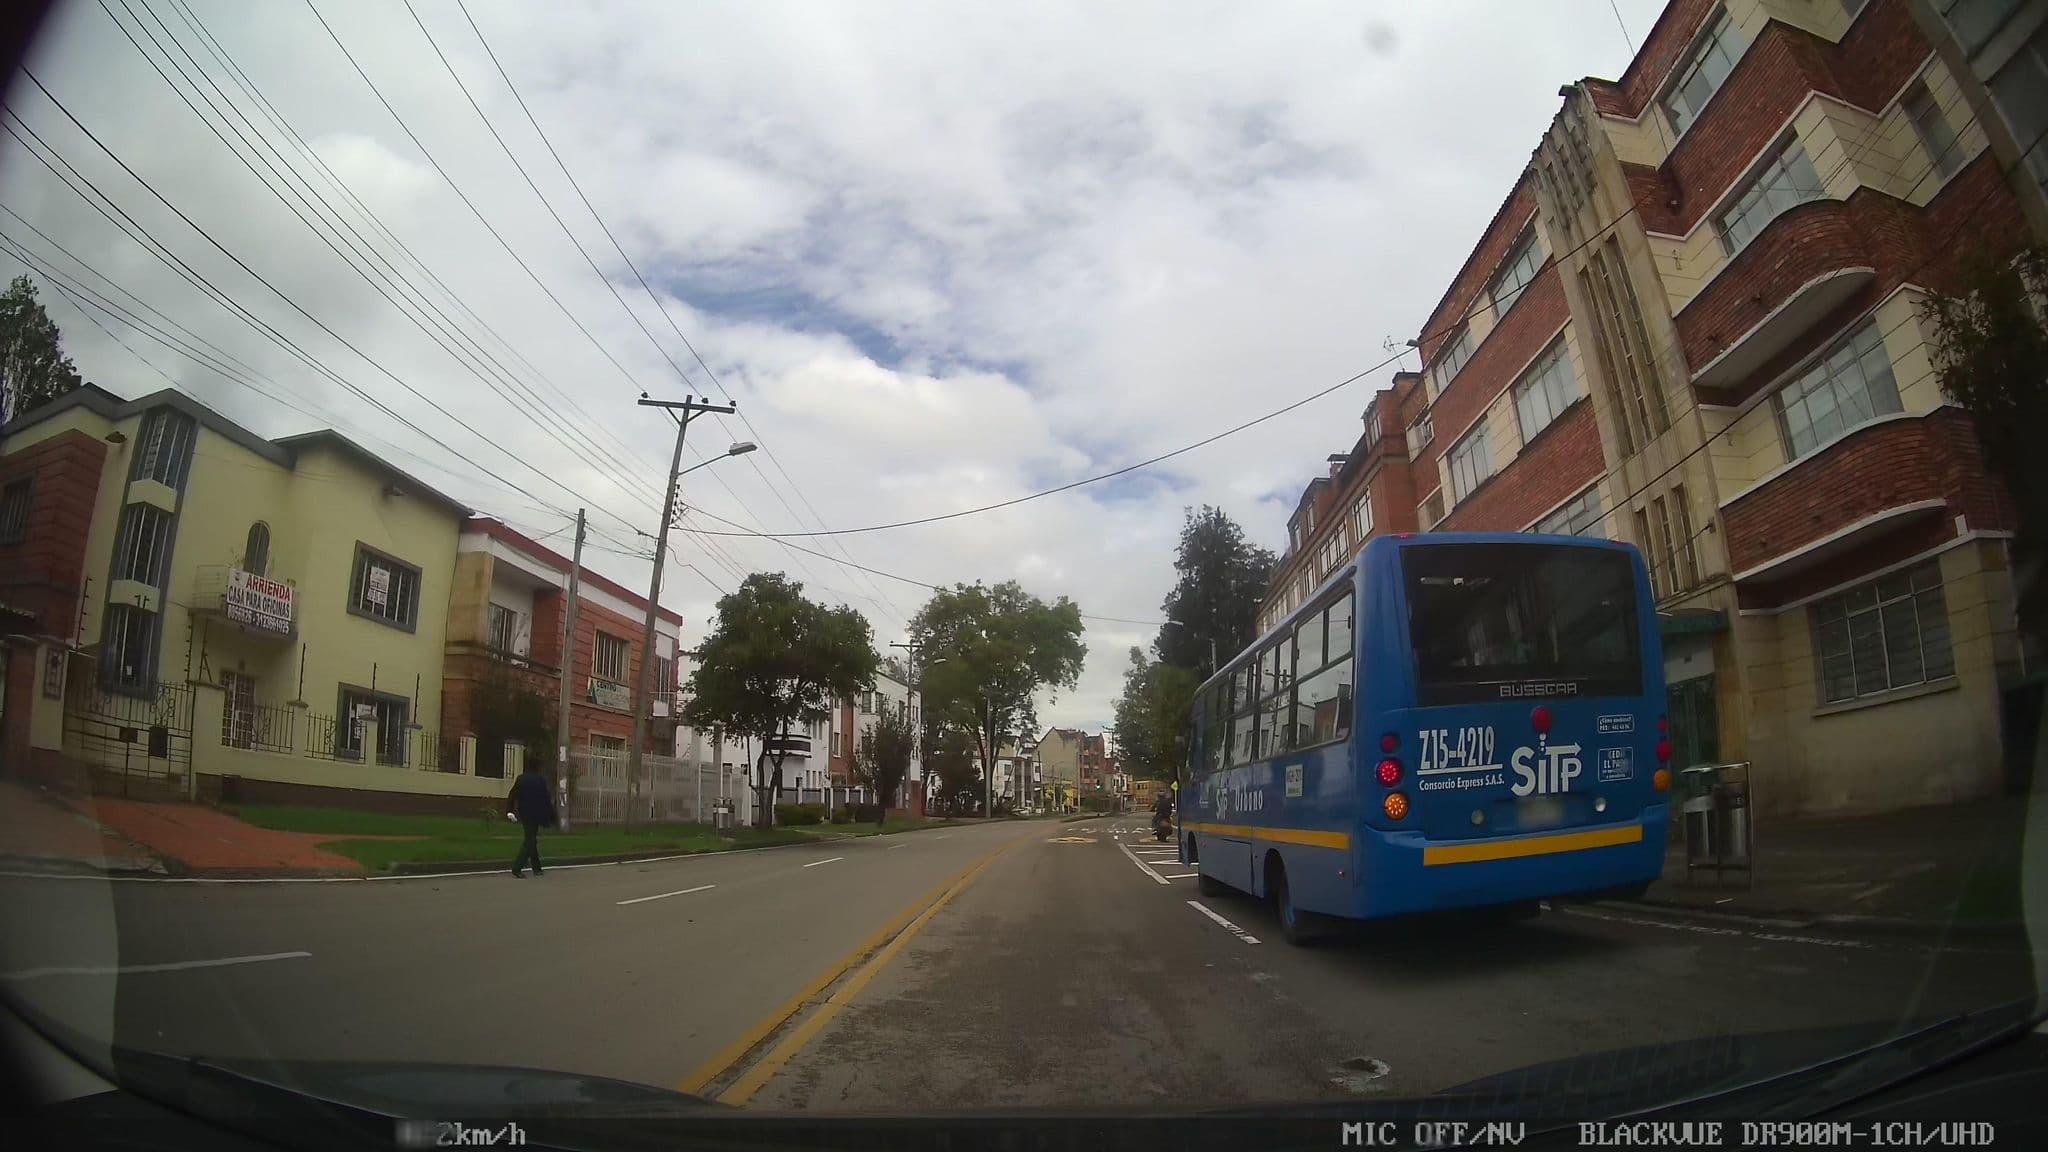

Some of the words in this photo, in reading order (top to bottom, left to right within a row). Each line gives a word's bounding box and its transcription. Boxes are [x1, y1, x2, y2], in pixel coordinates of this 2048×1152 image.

[246, 575, 290, 601] ARRIENDA
[228, 586, 245, 605] CASA
[246, 591, 262, 610] PARA
[263, 596, 290, 617] OFICINAS
[1500, 682, 1577, 697] BUSSCAR
[1419, 726, 1495, 770] Z15-4219
[1419, 777, 1456, 791] Consorcio
[1457, 776, 1484, 790] Express
[1485, 773, 1505, 786] S.A.S.
[1235, 785, 1263, 811] Urbano
